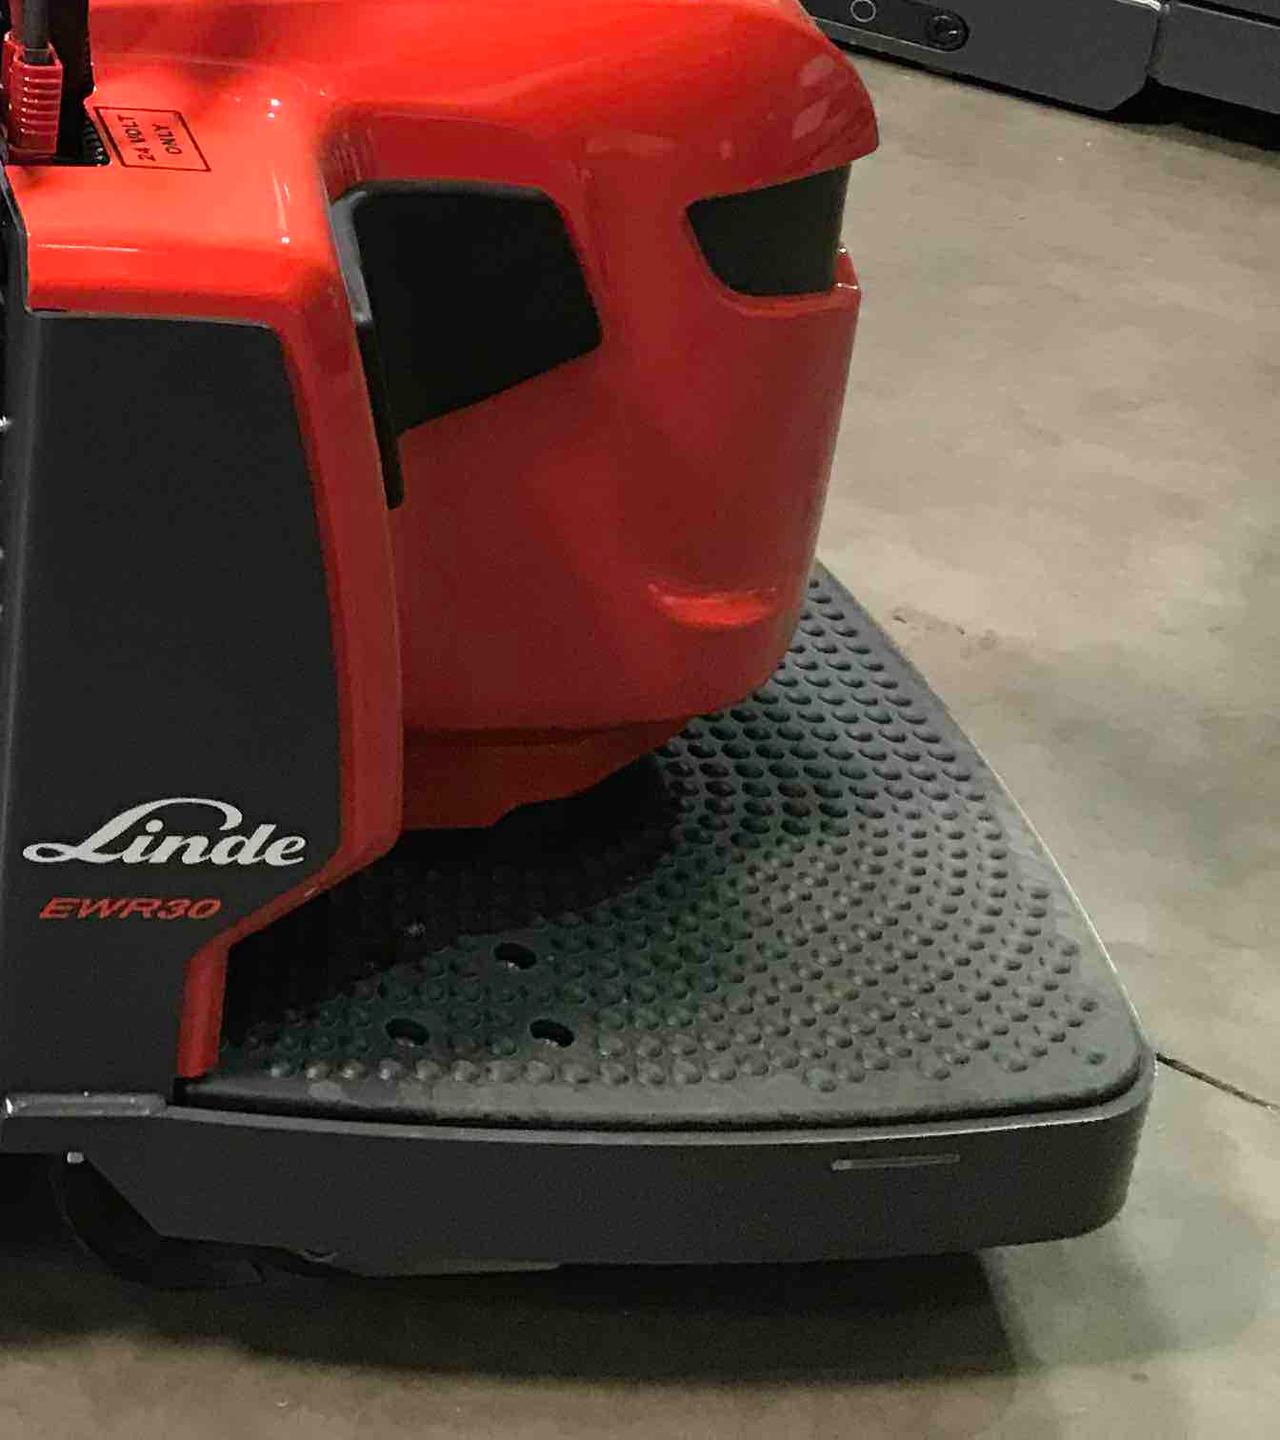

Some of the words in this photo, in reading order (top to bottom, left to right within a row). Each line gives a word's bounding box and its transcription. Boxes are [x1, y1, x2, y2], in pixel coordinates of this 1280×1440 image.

[117, 114, 146, 145] VOLT
[151, 123, 183, 156] ONLY
[135, 146, 156, 162] 24
[22, 797, 307, 867] Linde
[39, 895, 222, 921] EWR30
